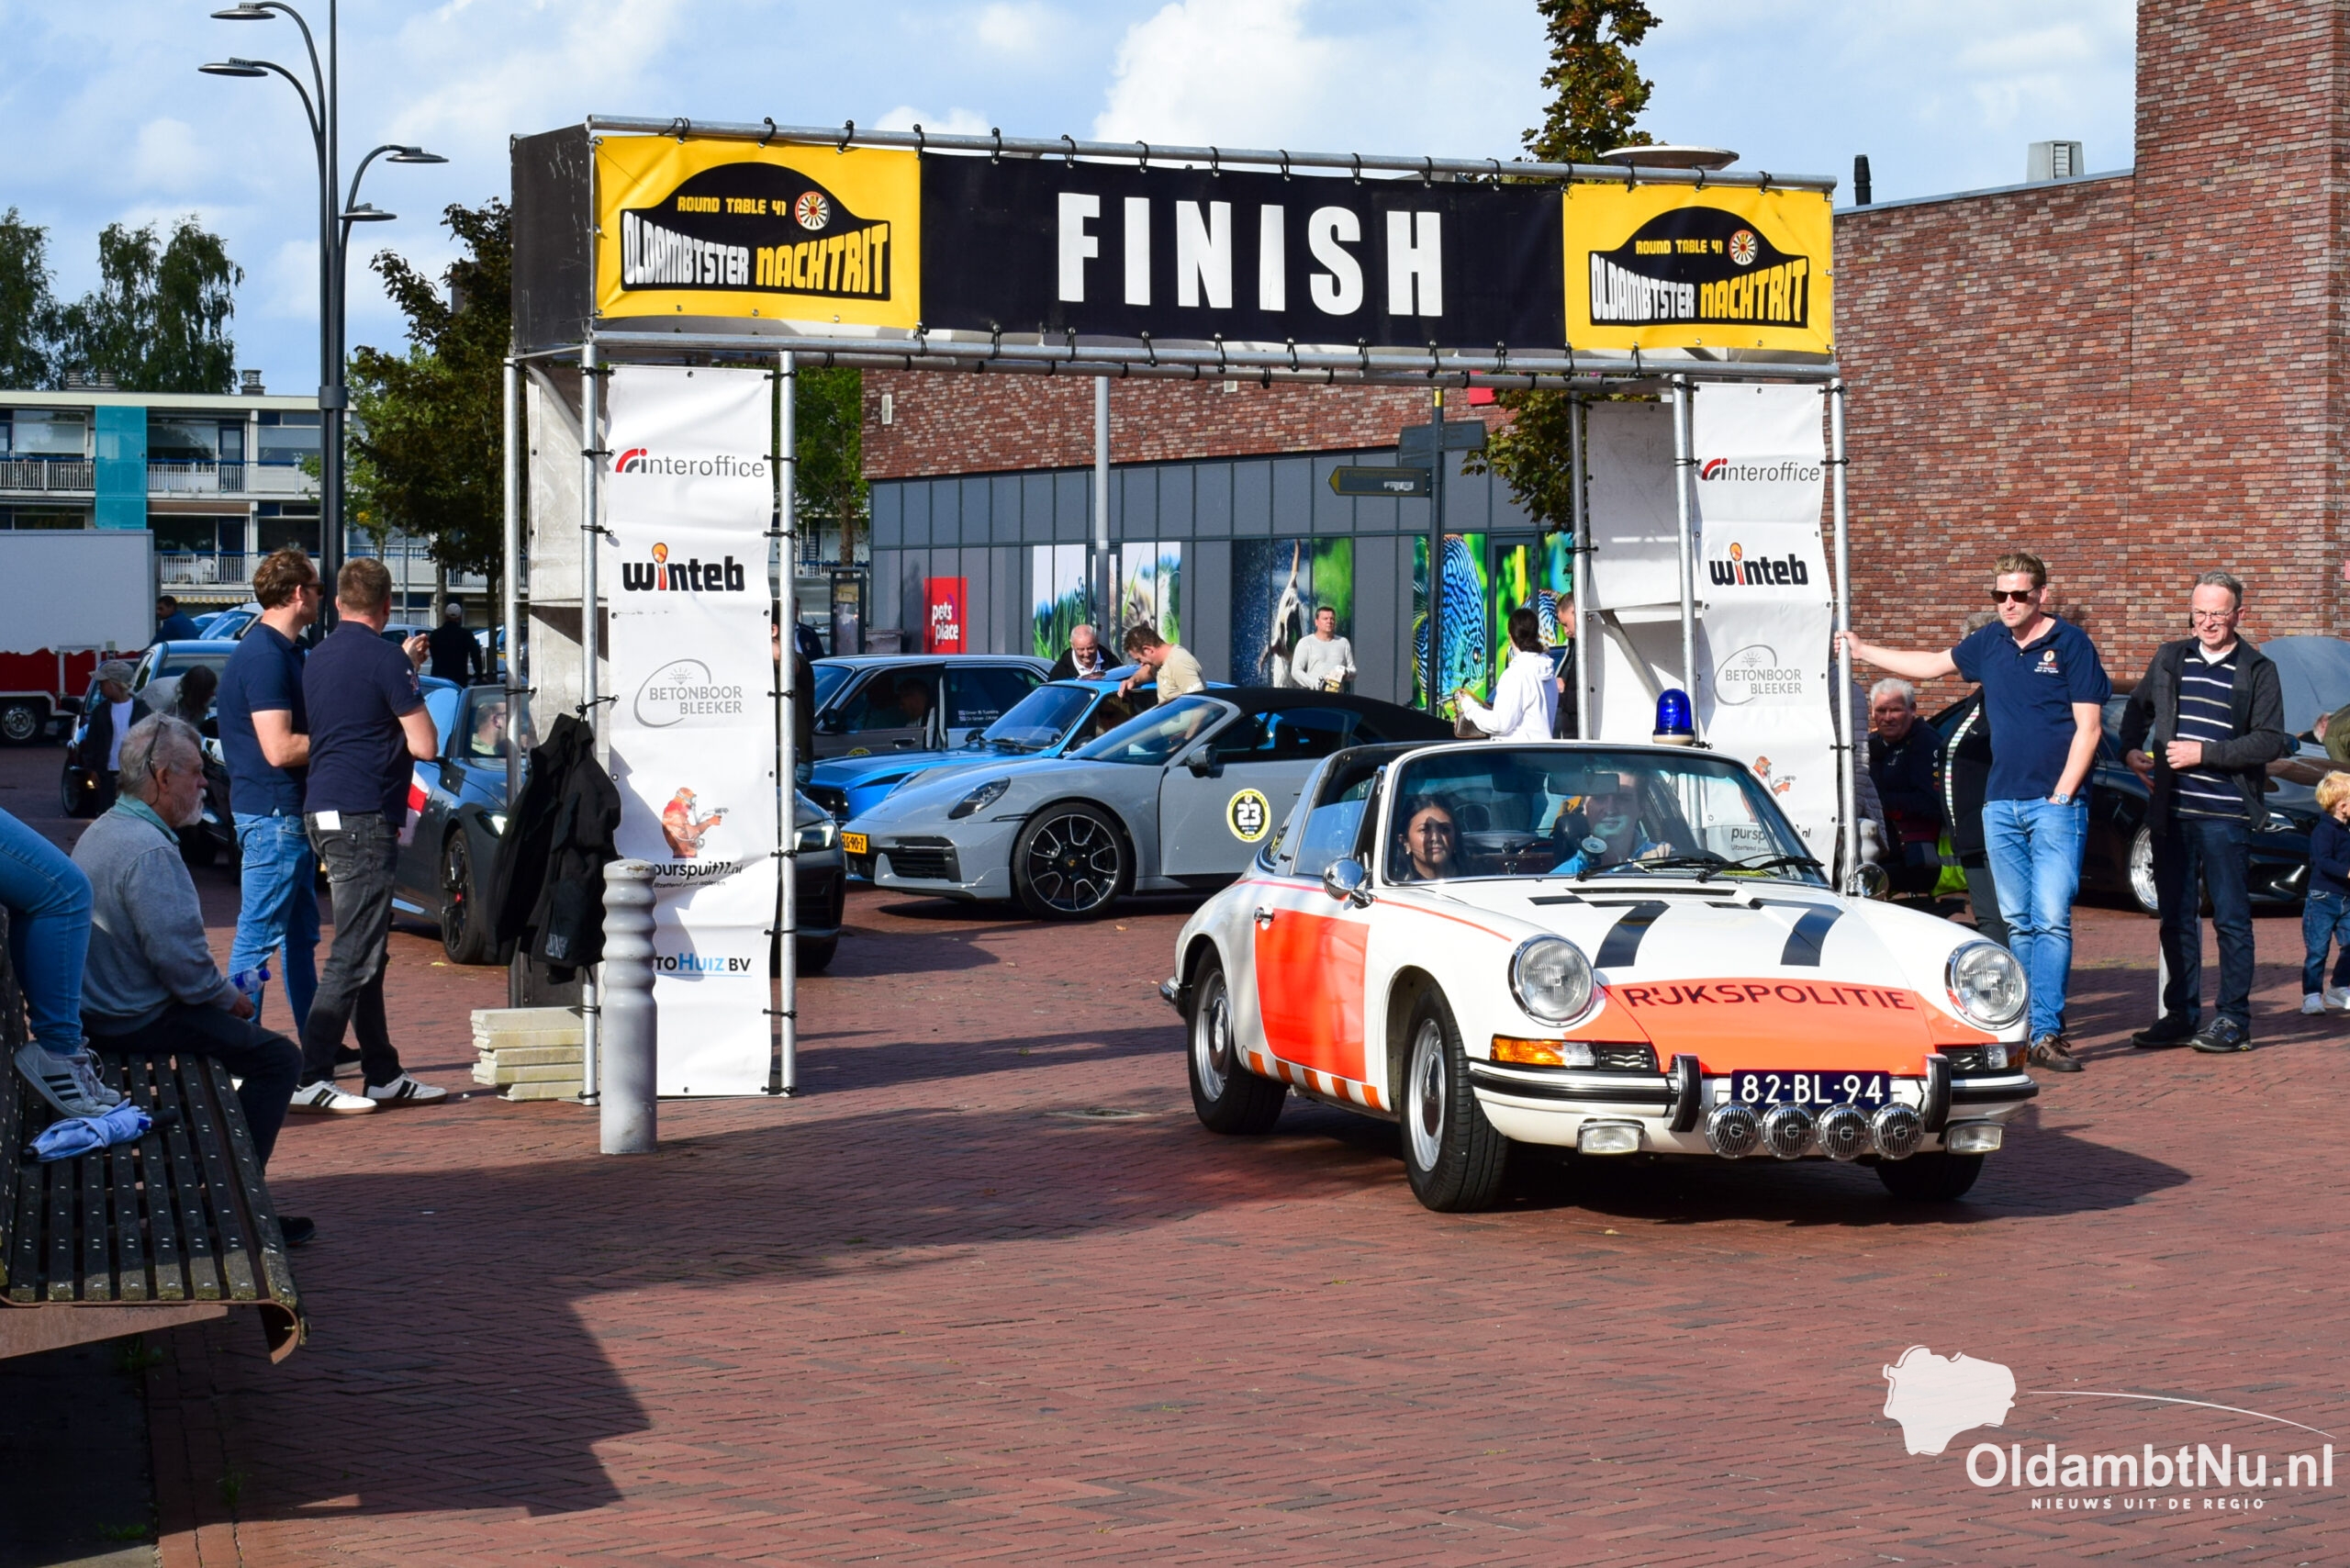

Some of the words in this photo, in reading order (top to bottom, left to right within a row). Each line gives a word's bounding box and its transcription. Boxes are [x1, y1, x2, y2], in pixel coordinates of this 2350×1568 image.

[677, 196, 720, 214] ROUND
[726, 197, 767, 215] TABLE
[771, 200, 787, 216] 41
[622, 210, 750, 286] OLDAMBTSTER
[756, 223, 890, 294] NACHTRIT
[1058, 192, 1443, 317] FINISH
[1636, 239, 1672, 255] ROUND
[1675, 239, 1707, 254] TABLE
[1711, 240, 1723, 255] 41
[1590, 252, 1695, 322] OLDAMBTSTER
[1700, 257, 1808, 322] NACHTRIT
[640, 448, 765, 477] interoffice
[1721, 457, 1820, 482] interoffice
[621, 542, 745, 592] winteb
[1708, 542, 1808, 587] winteb
[932, 601, 953, 626] pets
[934, 622, 959, 645] place
[1725, 667, 1803, 682] BETONBOOR
[649, 685, 743, 701] BETONBOOR
[1750, 682, 1803, 695] BLEEKER
[679, 700, 743, 714] BLEEKER
[1237, 802, 1261, 826] 23
[728, 958, 752, 972] BV
[1623, 983, 1916, 1011] RIJKSPOLITIE
[1740, 1073, 1884, 1104] 82-BL-94
